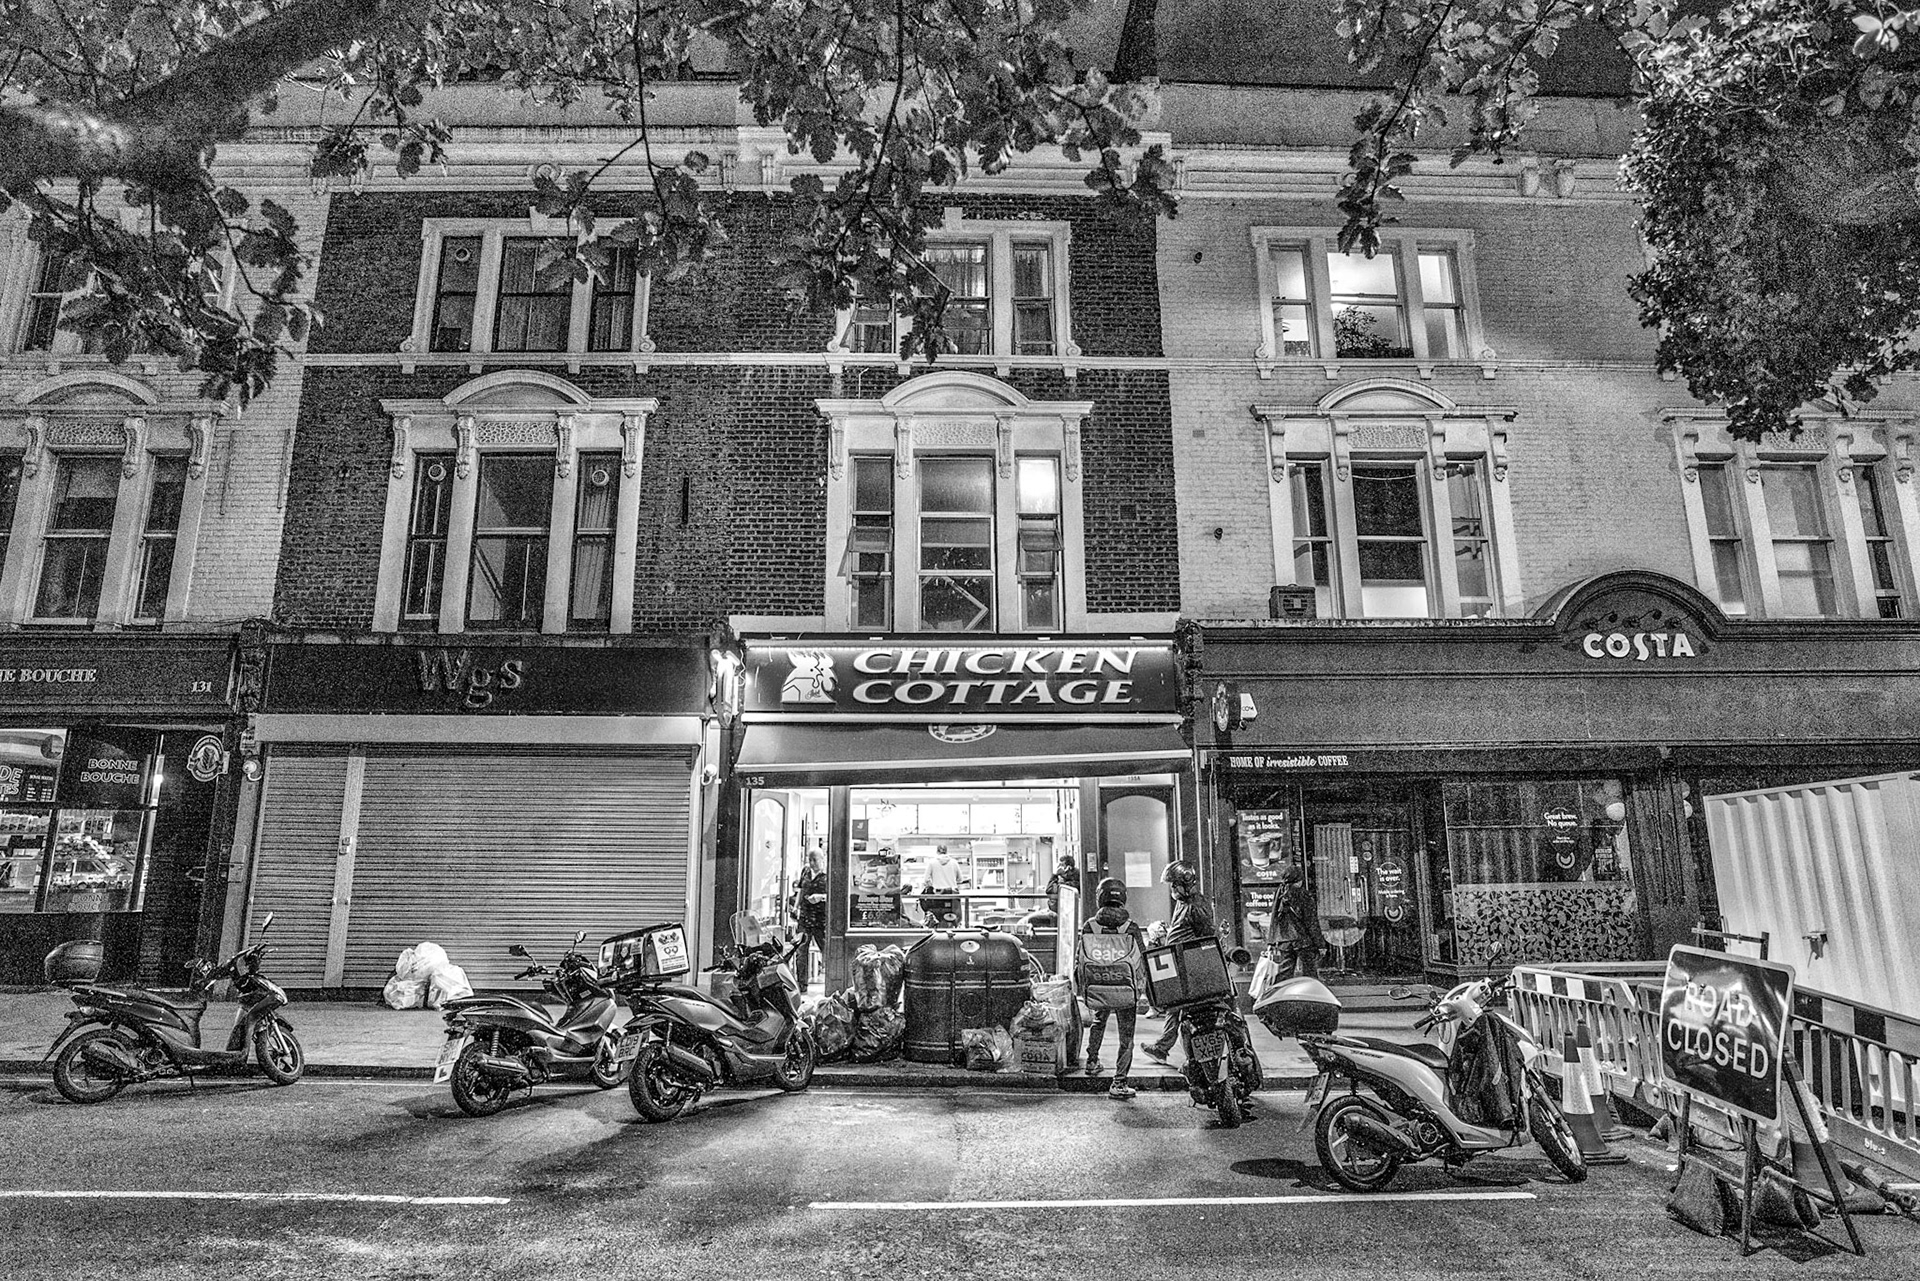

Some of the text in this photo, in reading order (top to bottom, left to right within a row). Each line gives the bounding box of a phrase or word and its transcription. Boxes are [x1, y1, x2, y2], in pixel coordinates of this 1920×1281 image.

[1583, 633, 1695, 660] COSTA
[853, 650, 1138, 674] CHICKEN
[19, 668, 97, 683] BOUCHE
[191, 681, 212, 693] 131
[852, 679, 1134, 704] COTTAGE
[88, 759, 138, 771] BONNE
[1229, 755, 1349, 768] HOME OF irresistible COFFEE
[80, 771, 140, 785] BOUCHE
[745, 776, 765, 786] 135
[1544, 812, 1561, 820] Great
[1256, 870, 1277, 878] COSTA
[1250, 892, 1262, 900] The
[1092, 948, 1126, 961] eats
[1093, 970, 1124, 981] eats
[1684, 981, 1754, 1028] ROAD
[1667, 1018, 1769, 1079] CLOSED
